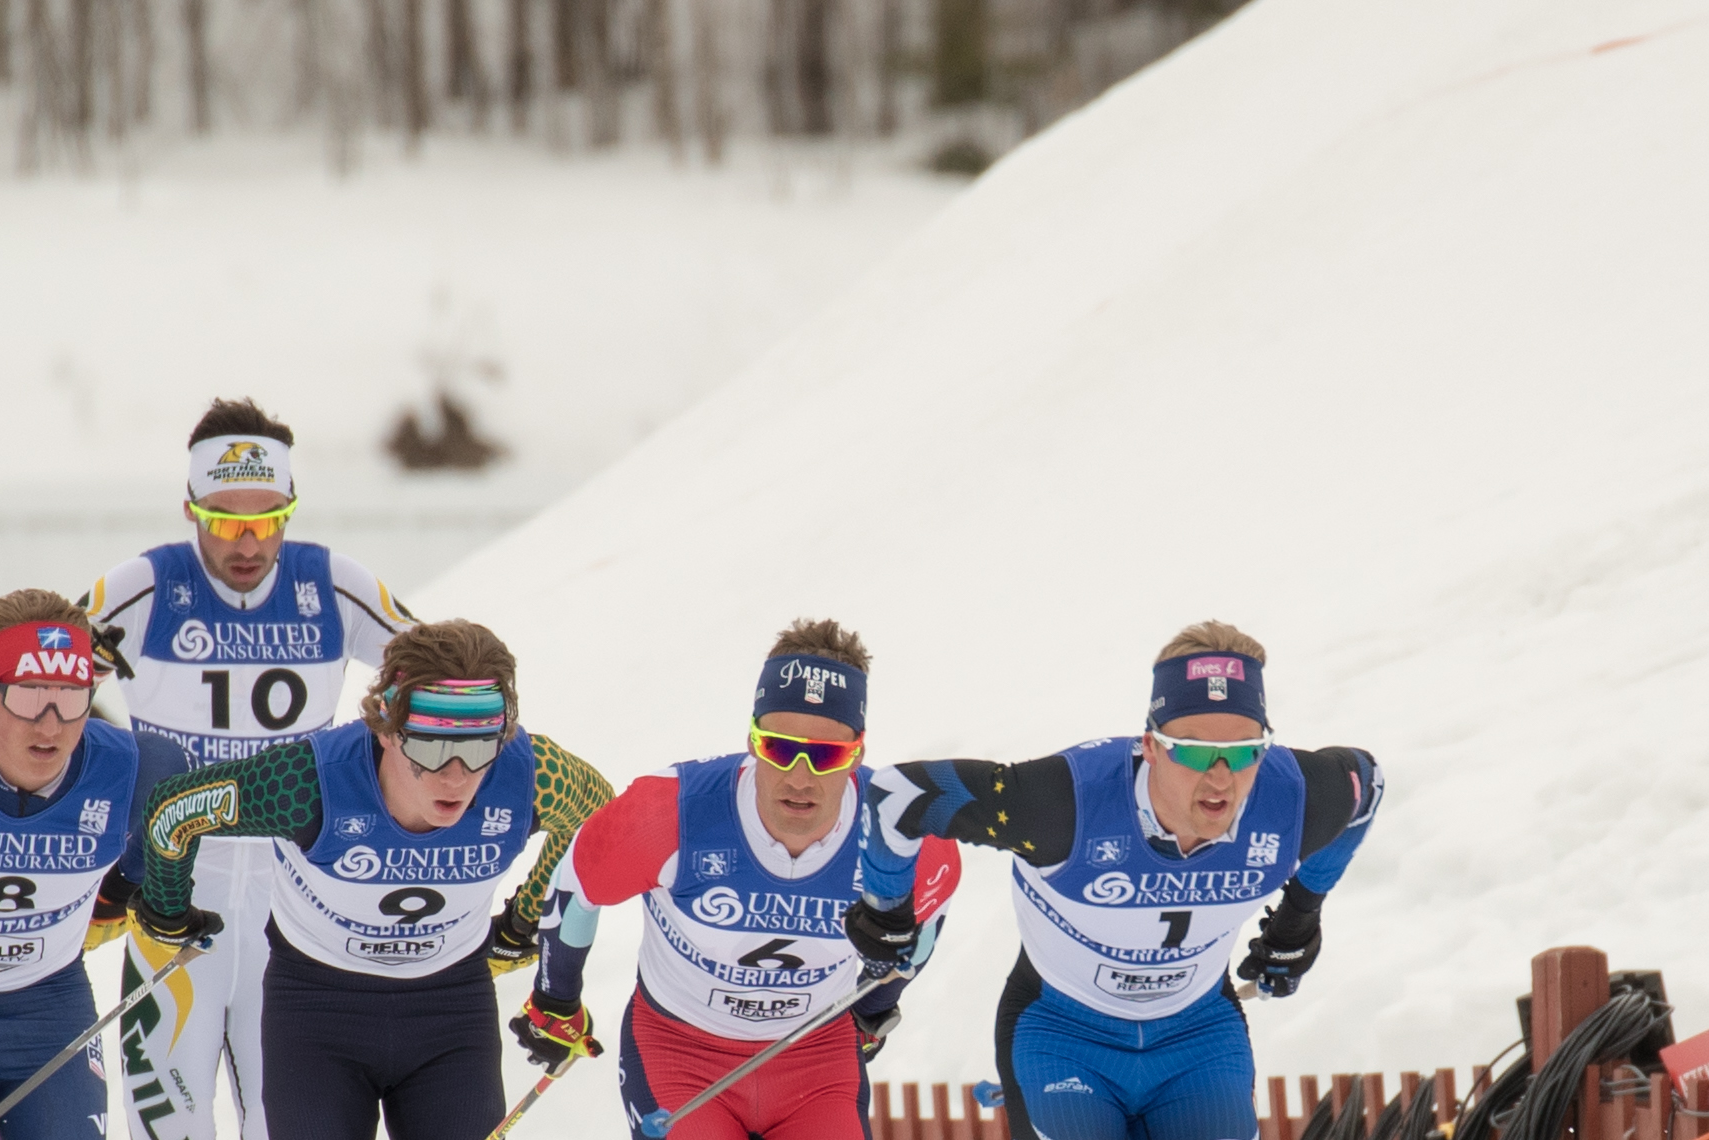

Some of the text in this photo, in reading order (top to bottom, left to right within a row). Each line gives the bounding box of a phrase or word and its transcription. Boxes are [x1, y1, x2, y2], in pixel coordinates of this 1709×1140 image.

[214, 622, 321, 645] UNITED
[215, 645, 324, 660] INSURANCE
[15, 651, 90, 681] AWS
[802, 665, 847, 690] ASPEN
[201, 668, 308, 731] 10
[484, 806, 513, 823] US
[1250, 832, 1281, 849] US
[385, 842, 502, 868] UNITED
[381, 861, 502, 881] INSURANCE
[1141, 869, 1266, 892] UNITED
[1135, 884, 1263, 904] INSURANCE
[378, 886, 447, 926] 9
[743, 914, 846, 935] INSURAN
[1159, 910, 1193, 949] 1
[648, 902, 715, 972] NORDIC
[714, 962, 820, 986] HERITAGE
[737, 938, 806, 970] 6
[1110, 970, 1188, 984] FIELDS
[723, 994, 801, 1010] FIELDS
[730, 1007, 788, 1018] REALTY
[170, 1067, 194, 1106] CRAFT
